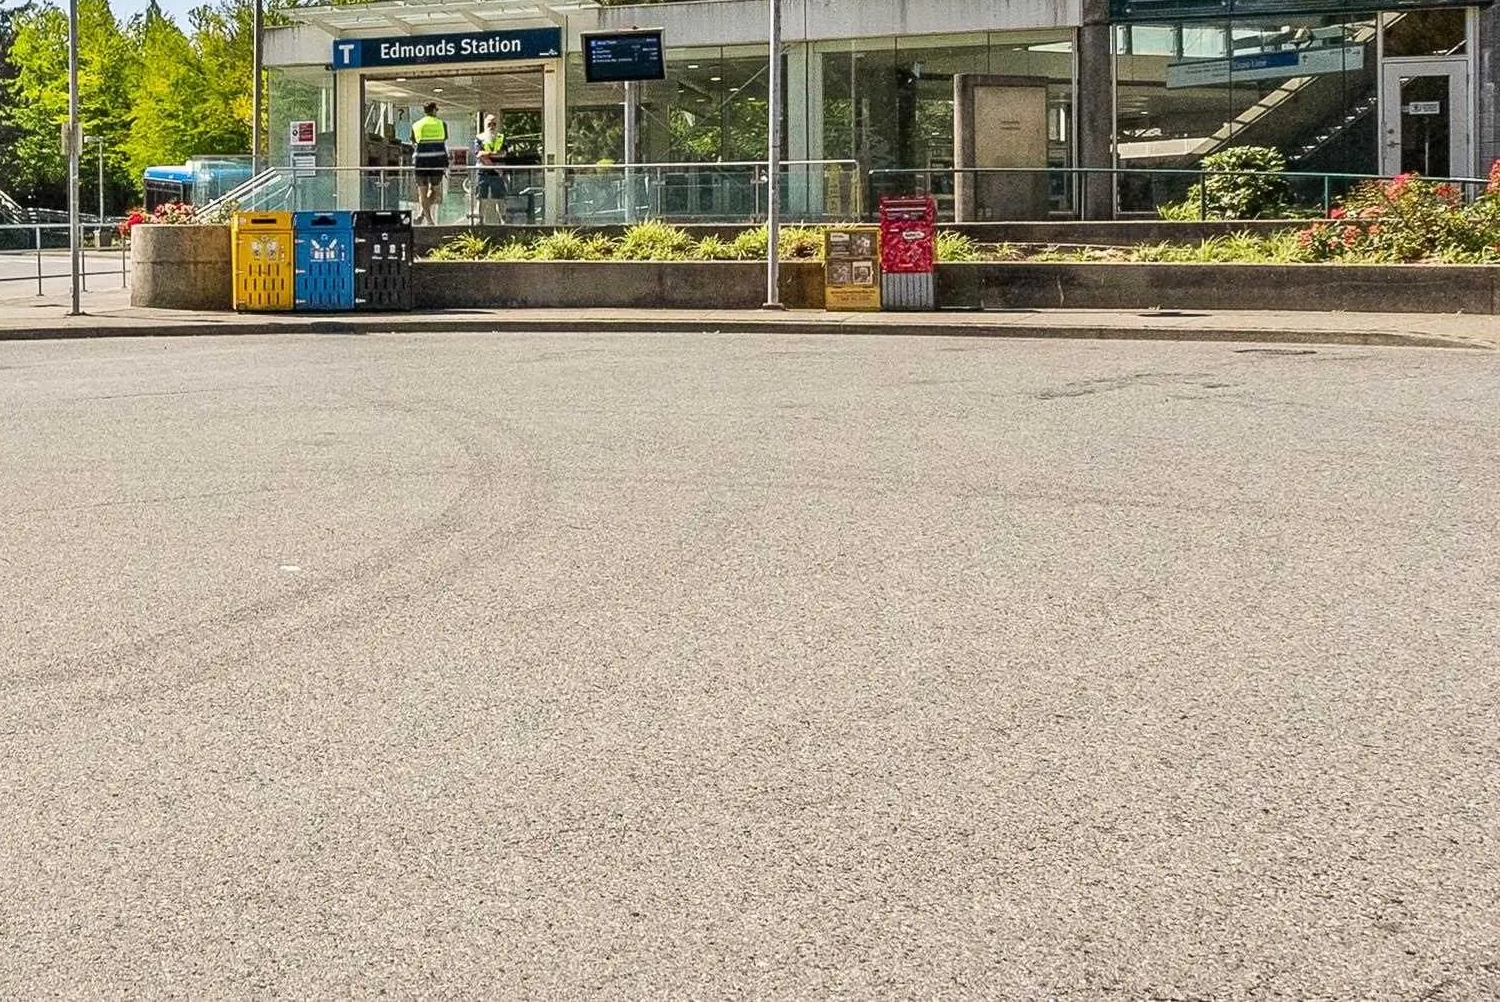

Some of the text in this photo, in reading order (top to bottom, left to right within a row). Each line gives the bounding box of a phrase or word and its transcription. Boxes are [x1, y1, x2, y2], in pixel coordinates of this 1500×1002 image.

[338, 36, 521, 64] T Edmonds Station
